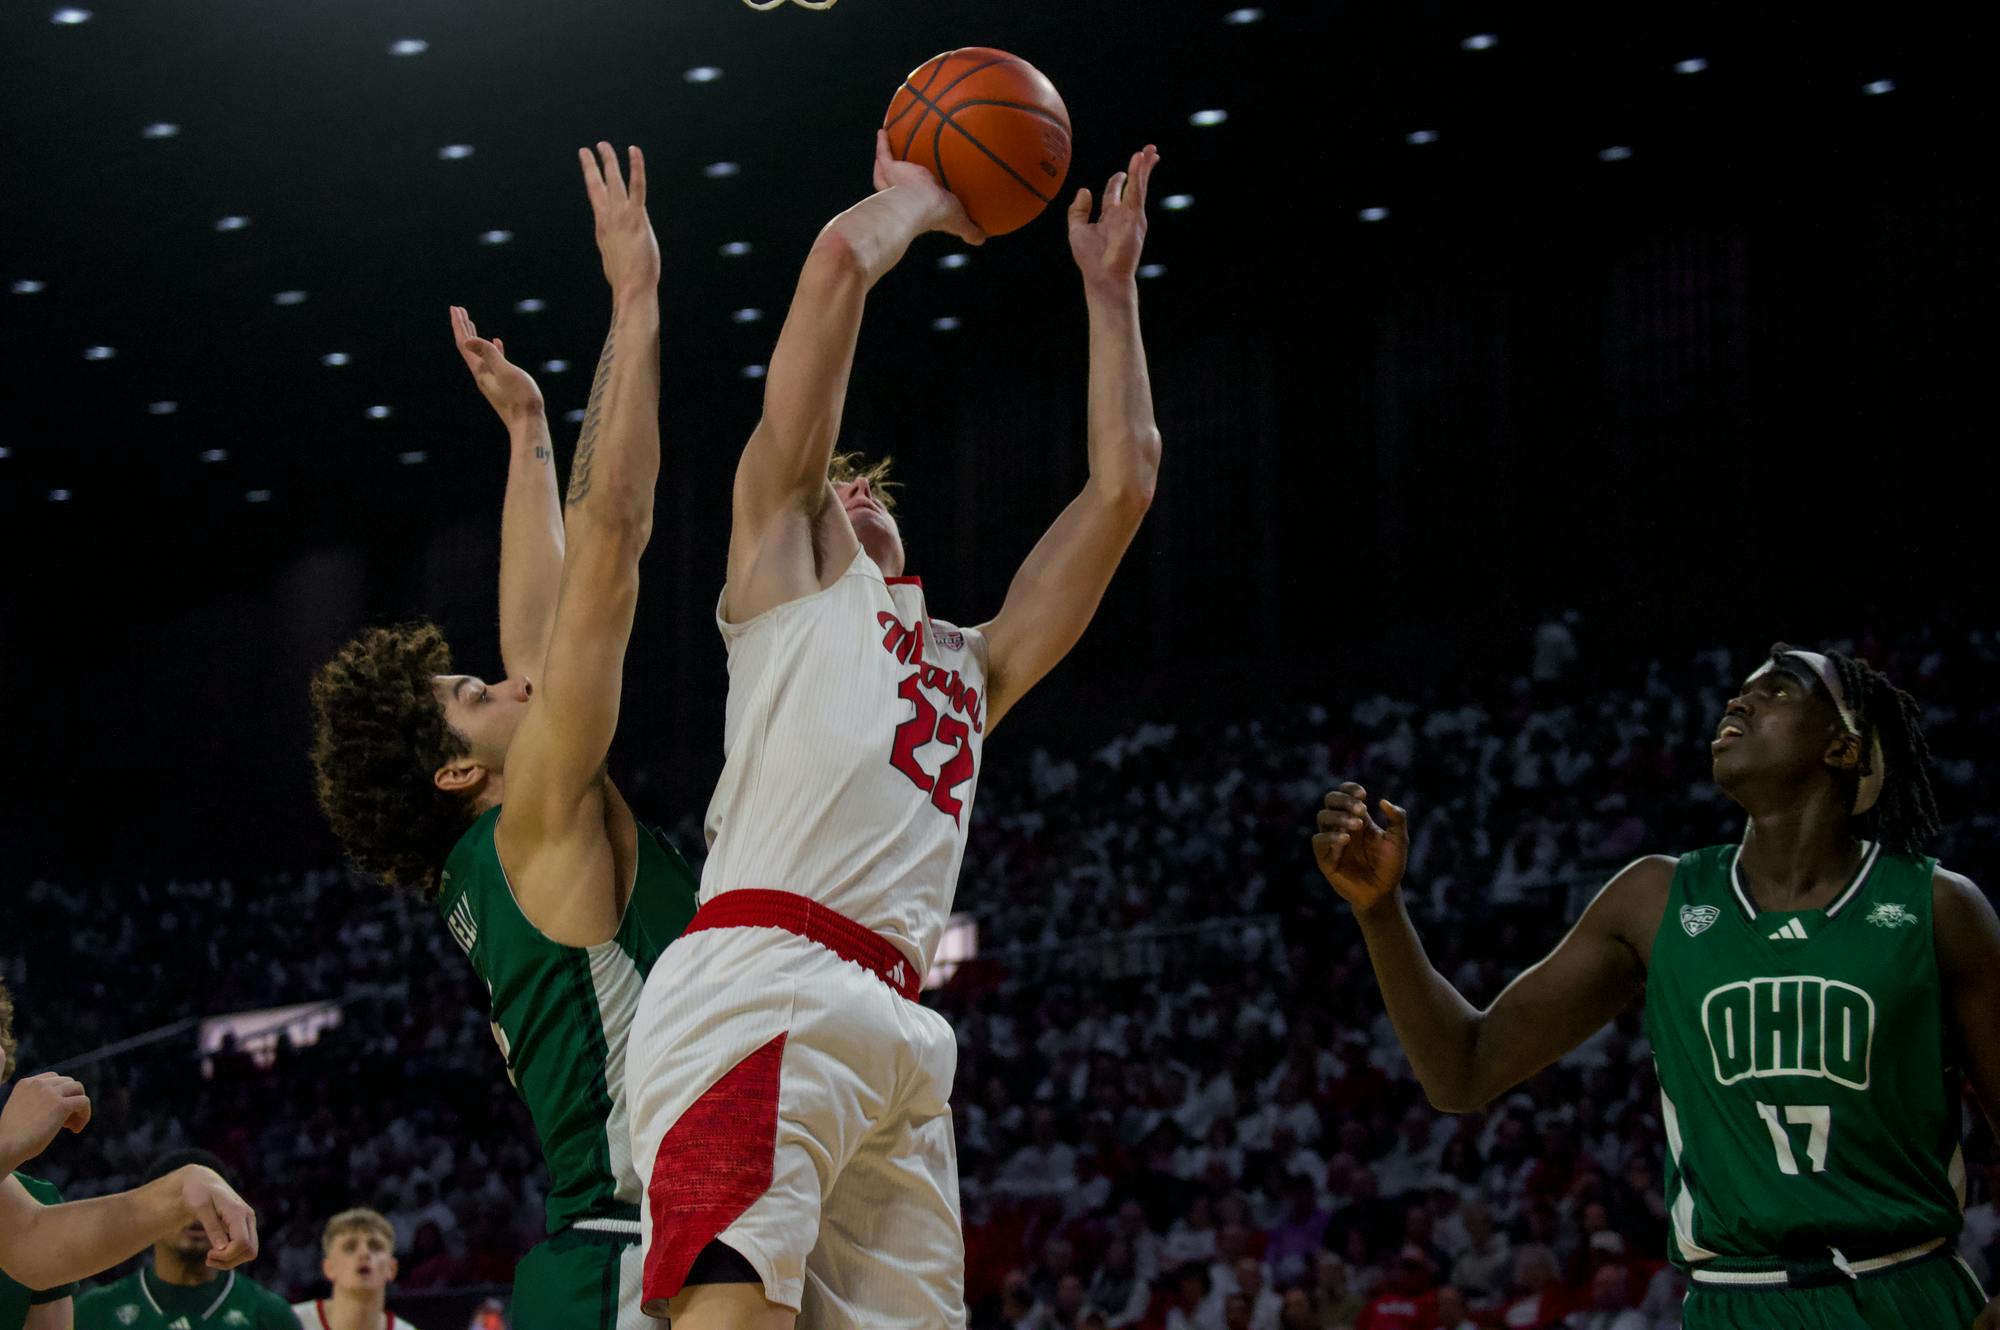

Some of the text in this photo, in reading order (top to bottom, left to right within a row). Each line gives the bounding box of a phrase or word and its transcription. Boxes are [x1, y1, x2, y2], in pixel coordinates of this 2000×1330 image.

[876, 610, 983, 734] Mami
[888, 672, 975, 833] 22
[447, 889, 479, 955] ELLY
[1701, 975, 1876, 1091] OHIO
[1756, 1100, 1832, 1176] 17
